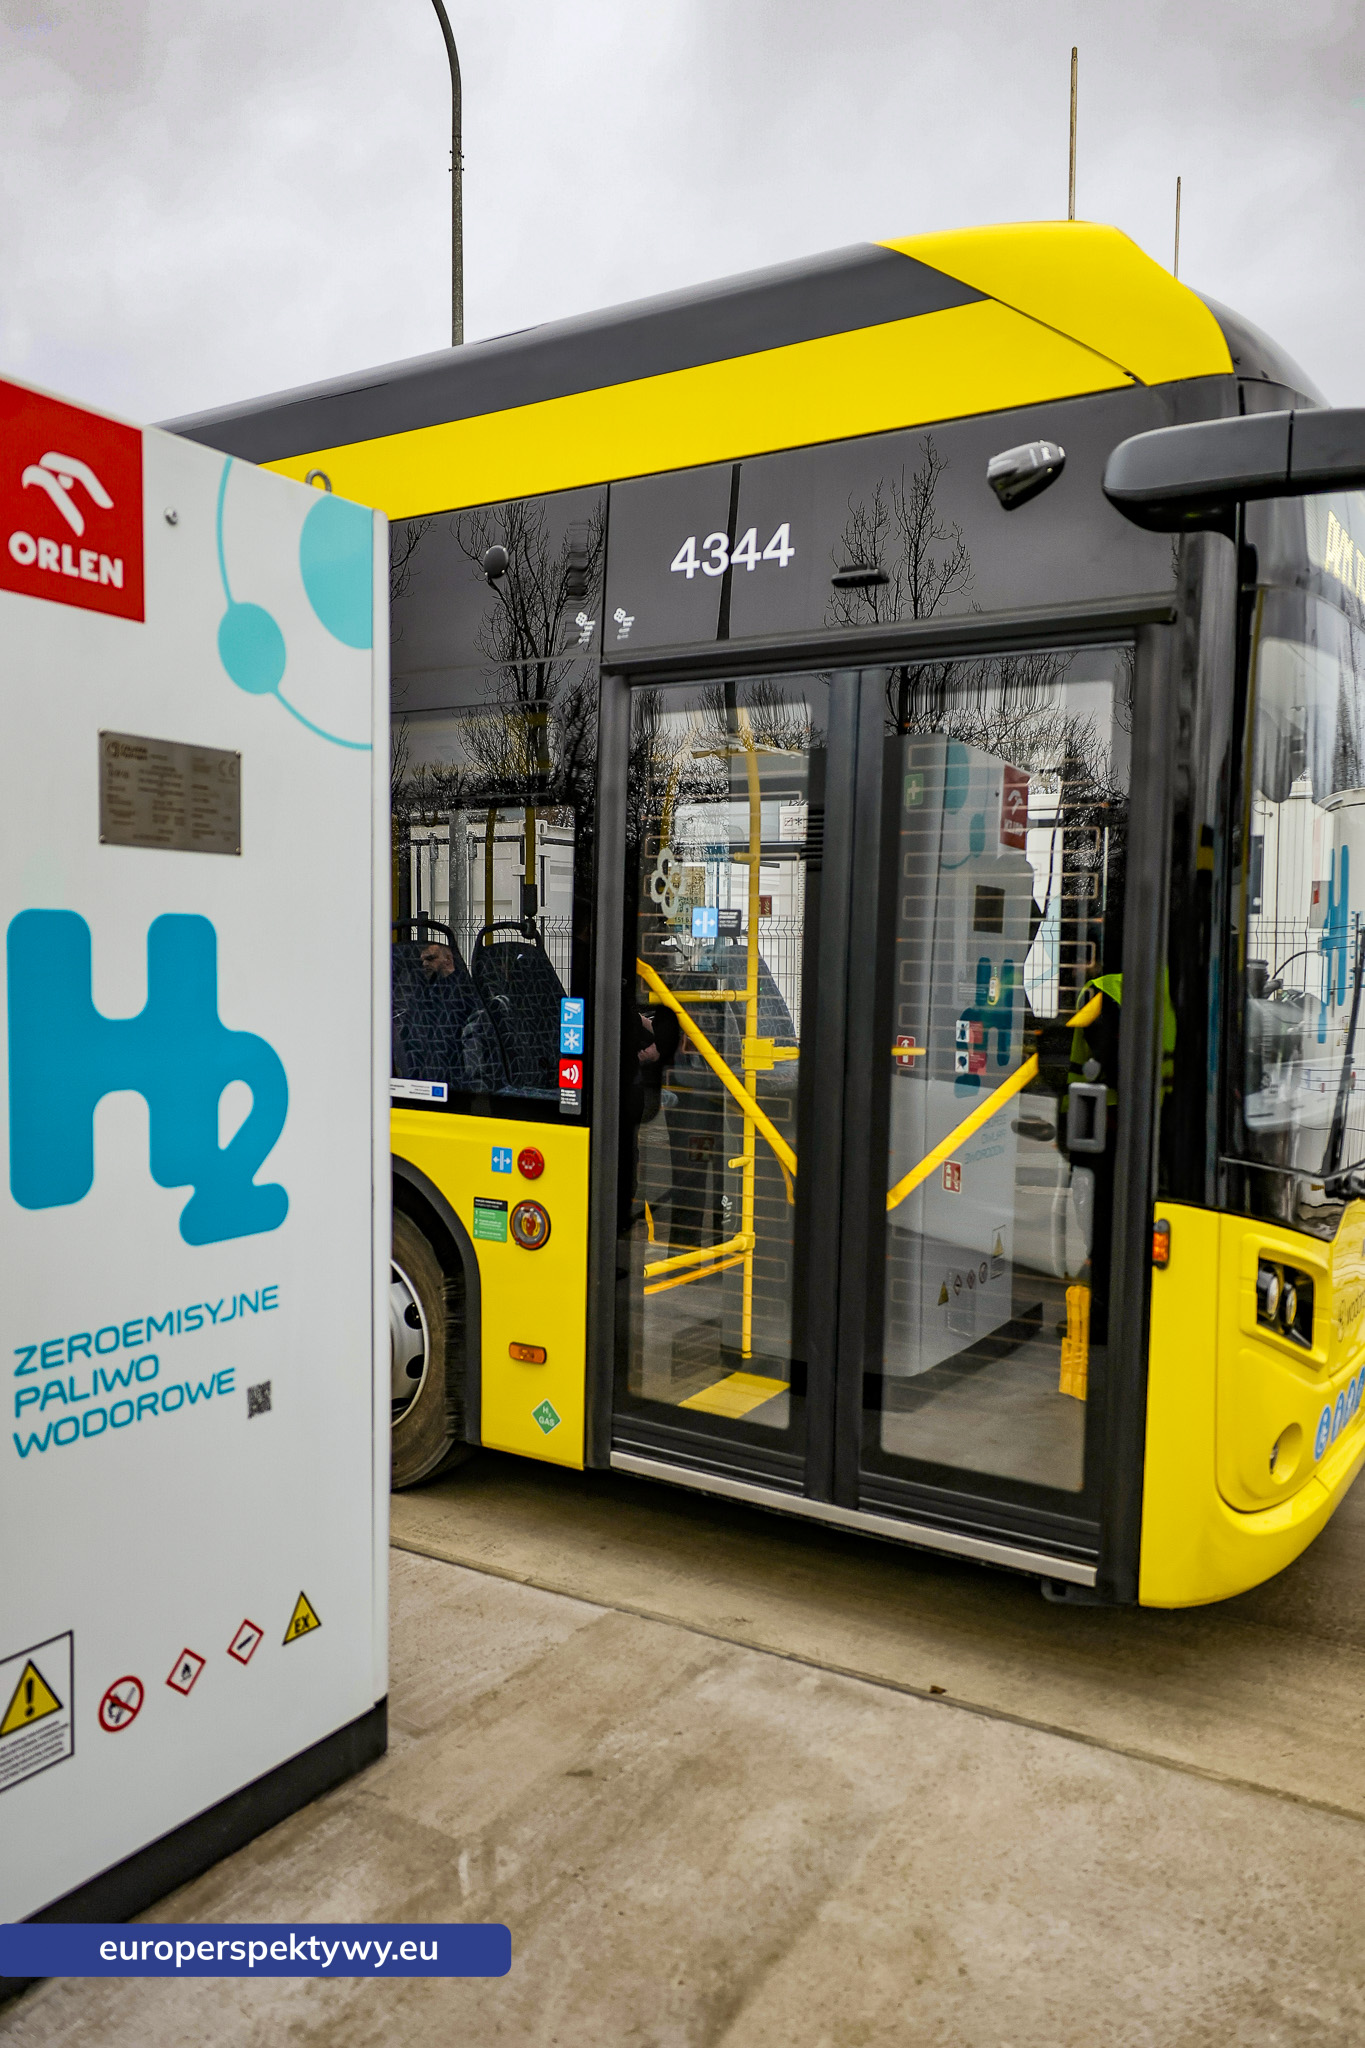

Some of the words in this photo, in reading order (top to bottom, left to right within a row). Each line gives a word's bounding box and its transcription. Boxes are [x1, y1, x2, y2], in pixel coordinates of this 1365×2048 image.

[8, 530, 123, 589] ORLEN
[671, 523, 795, 579] 4344
[7, 909, 289, 1247] H2
[14, 1285, 279, 1378] ZEROEMISYJNE
[13, 1367, 235, 1459] WODOROWE
[14, 1354, 160, 1419] PALIWO
[294, 1612, 311, 1634] EX
